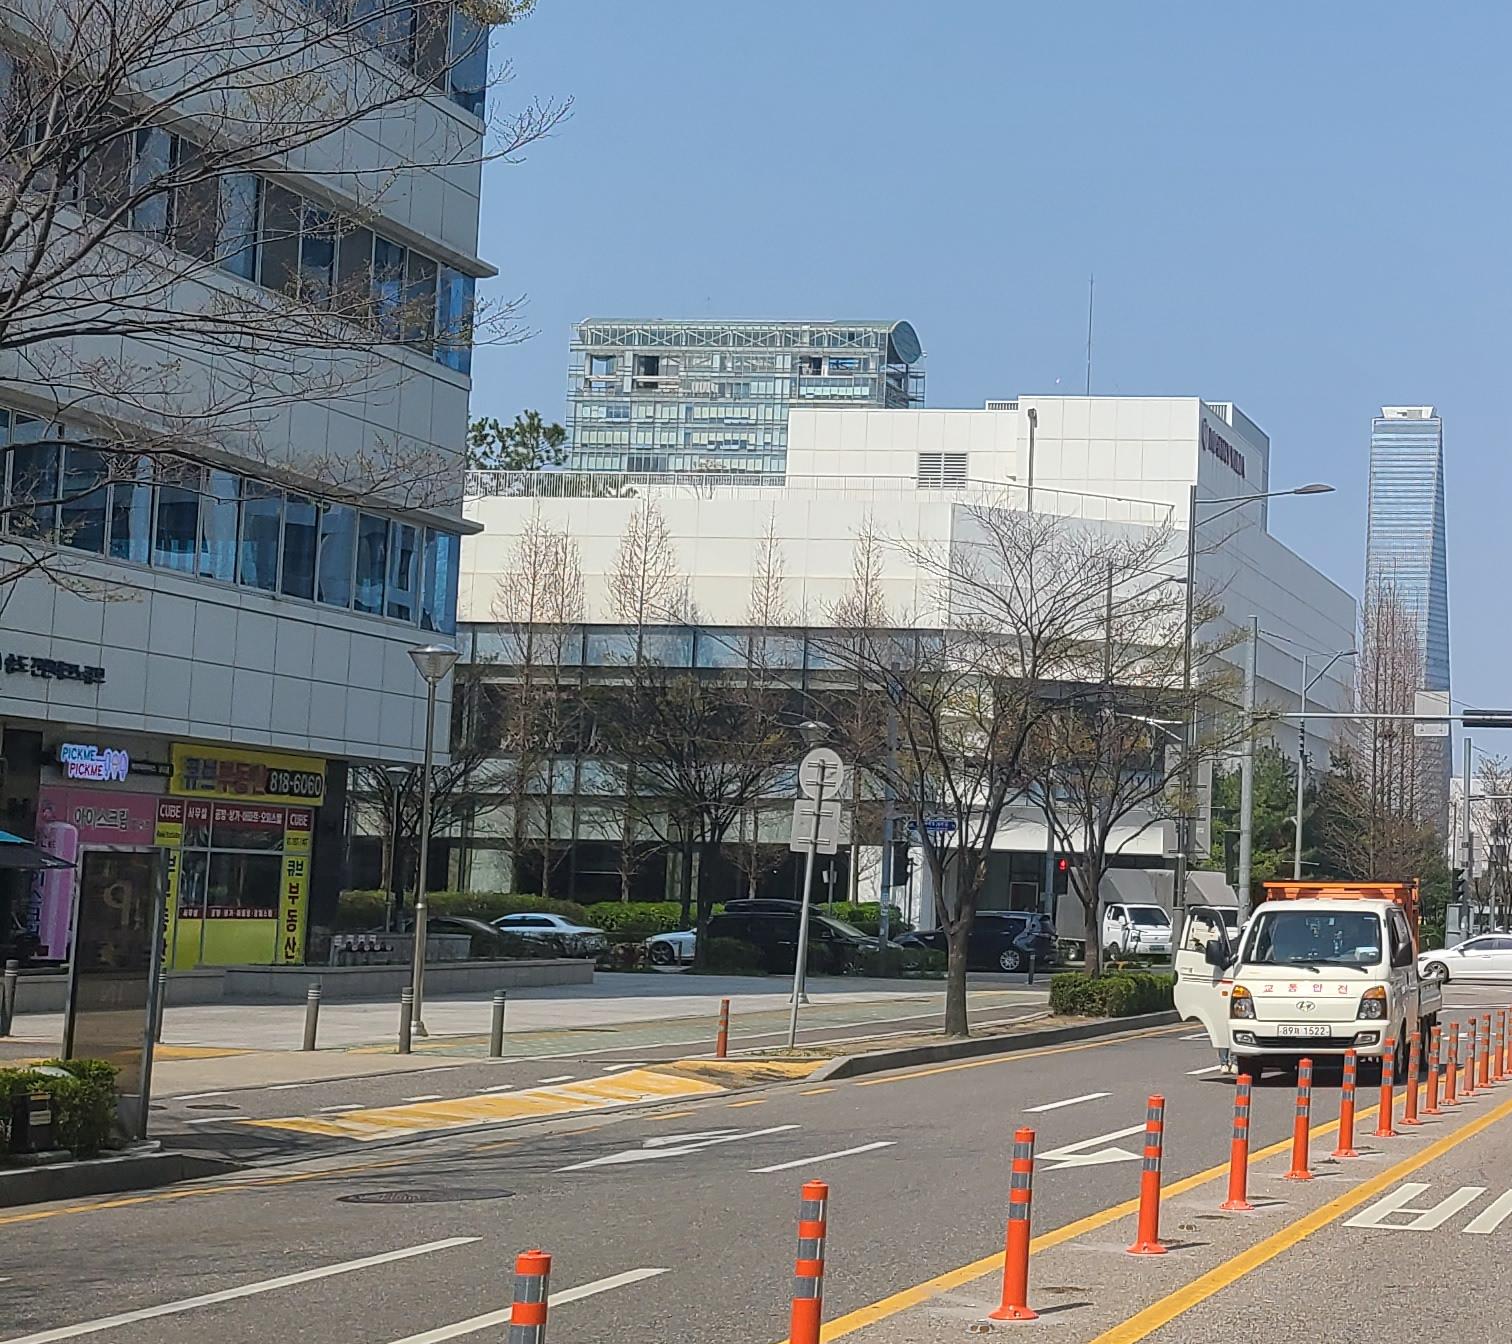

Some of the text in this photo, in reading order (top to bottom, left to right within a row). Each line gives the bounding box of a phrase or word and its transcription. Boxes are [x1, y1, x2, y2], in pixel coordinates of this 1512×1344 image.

[62, 746, 96, 761] PICKME
[70, 762, 103, 777] PICKME
[269, 771, 322, 796] 818-6060
[74, 807, 128, 831] 아이스크림
[160, 804, 181, 819] CUBE
[290, 813, 308, 827] CUBE
[285, 882, 300, 962] 부동산
[1304, 1026, 1326, 1035] 1522
